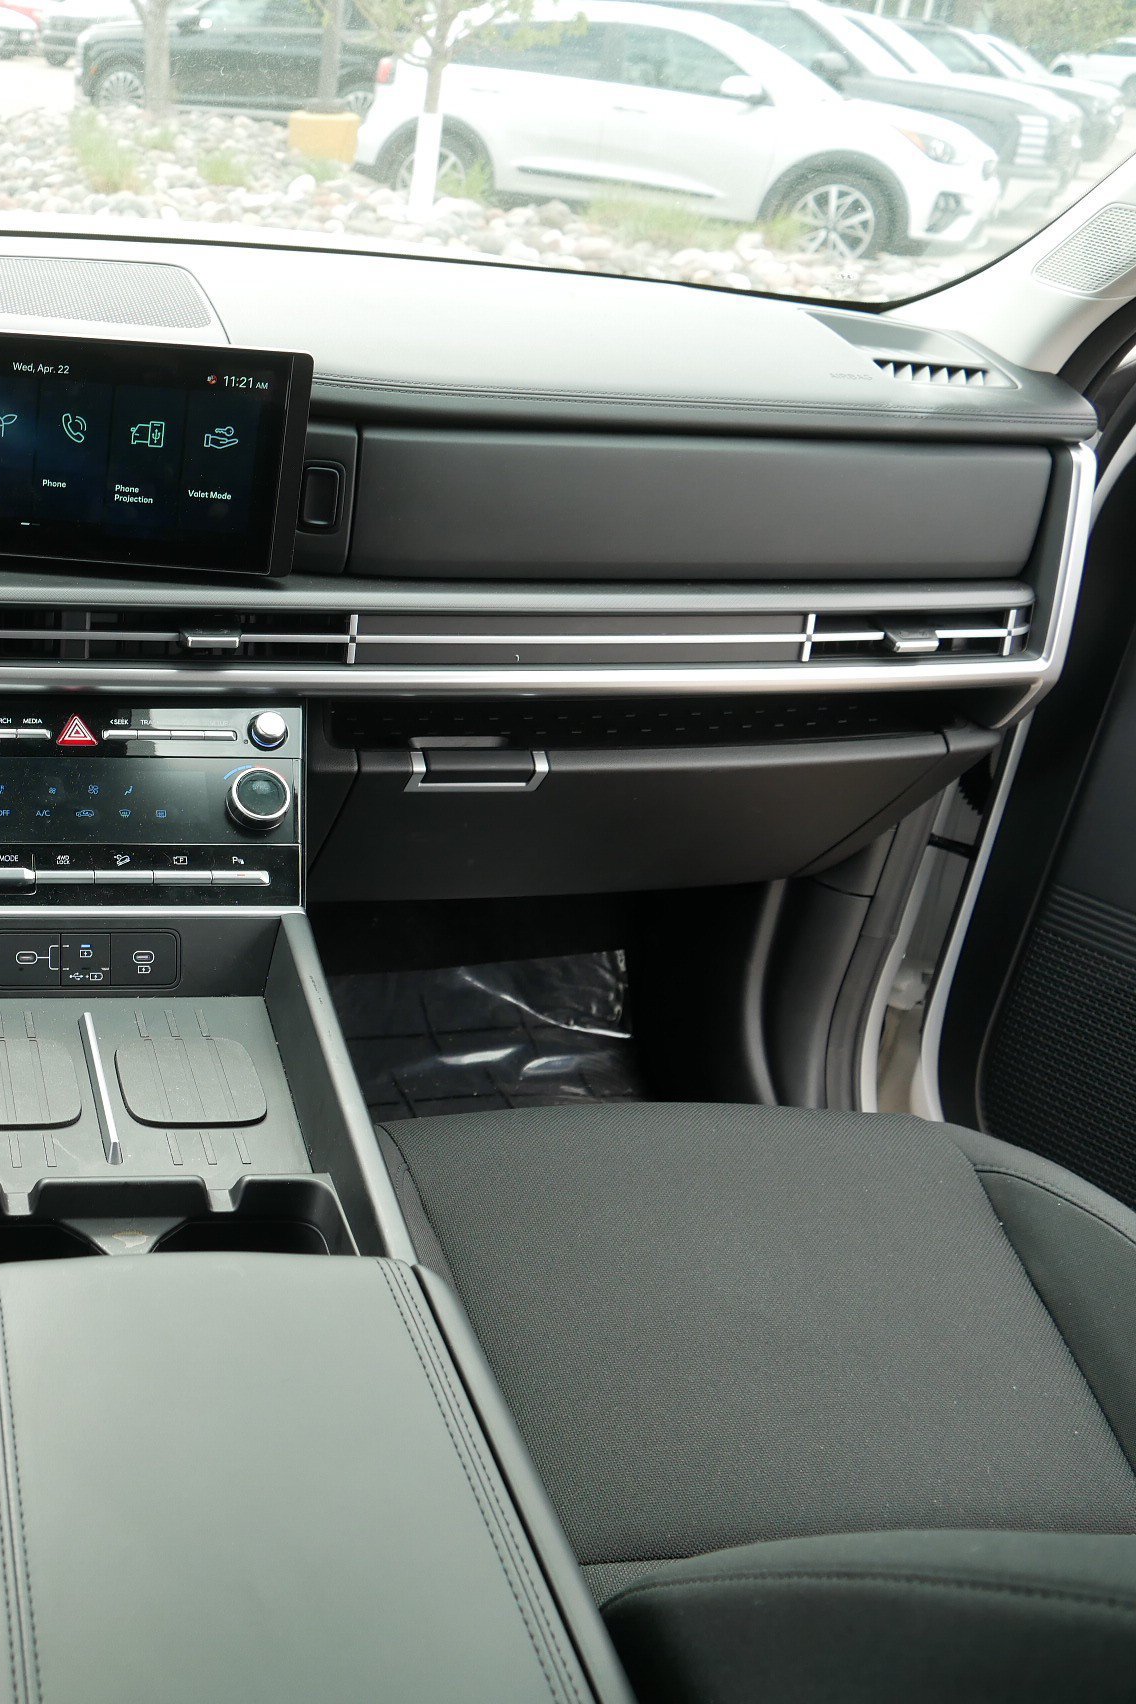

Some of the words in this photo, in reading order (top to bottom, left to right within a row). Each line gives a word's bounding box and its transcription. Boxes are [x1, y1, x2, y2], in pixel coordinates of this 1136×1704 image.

[12, 362, 35, 373] Wed,
[37, 363, 56, 375] Apr.
[58, 364, 70, 374] 22
[223, 375, 253, 389] 11:21
[255, 382, 269, 390] AM
[42, 479, 67, 488] Phone
[114, 484, 140, 493] Phone
[114, 494, 154, 504] Projection
[187, 489, 208, 499] Valet
[209, 491, 232, 500] Mode
